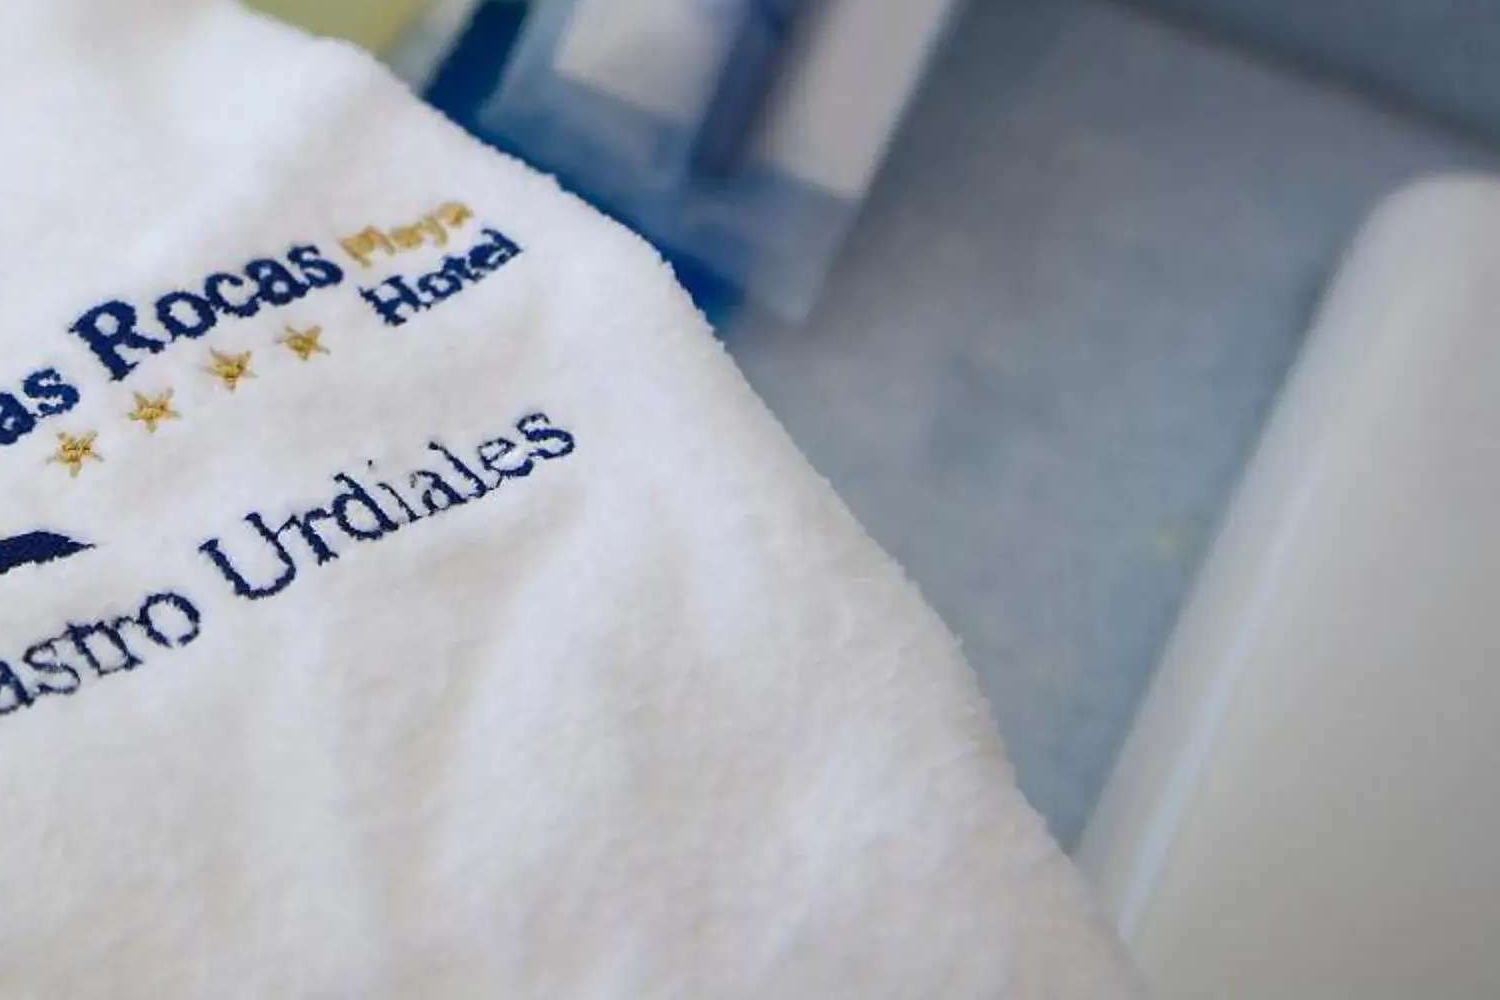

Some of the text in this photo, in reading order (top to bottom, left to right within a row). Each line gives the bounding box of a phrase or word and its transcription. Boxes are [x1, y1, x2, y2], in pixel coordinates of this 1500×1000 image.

[69, 244, 345, 382] Rocas
[338, 201, 474, 267] Playa
[358, 227, 524, 325] Hotel
[198, 412, 577, 600] Urdiales
